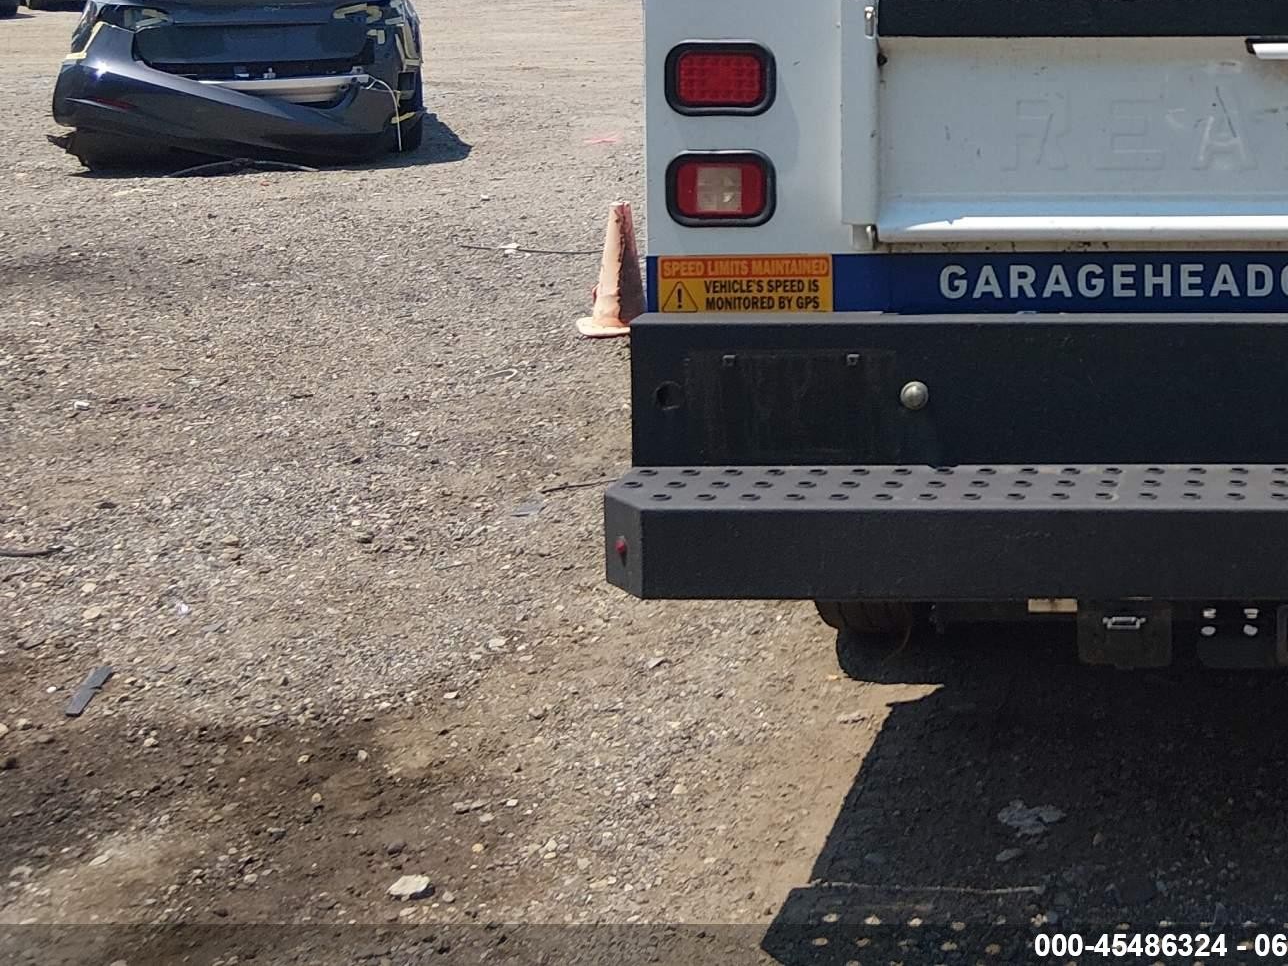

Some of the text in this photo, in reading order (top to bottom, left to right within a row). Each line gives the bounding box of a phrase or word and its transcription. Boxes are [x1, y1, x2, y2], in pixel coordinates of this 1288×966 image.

[663, 258, 828, 277] SPEED LIMITS MAINTAINED
[704, 279, 820, 294] VEHICLE'S SPEED IS
[705, 296, 820, 311] MONITORED BY GPS
